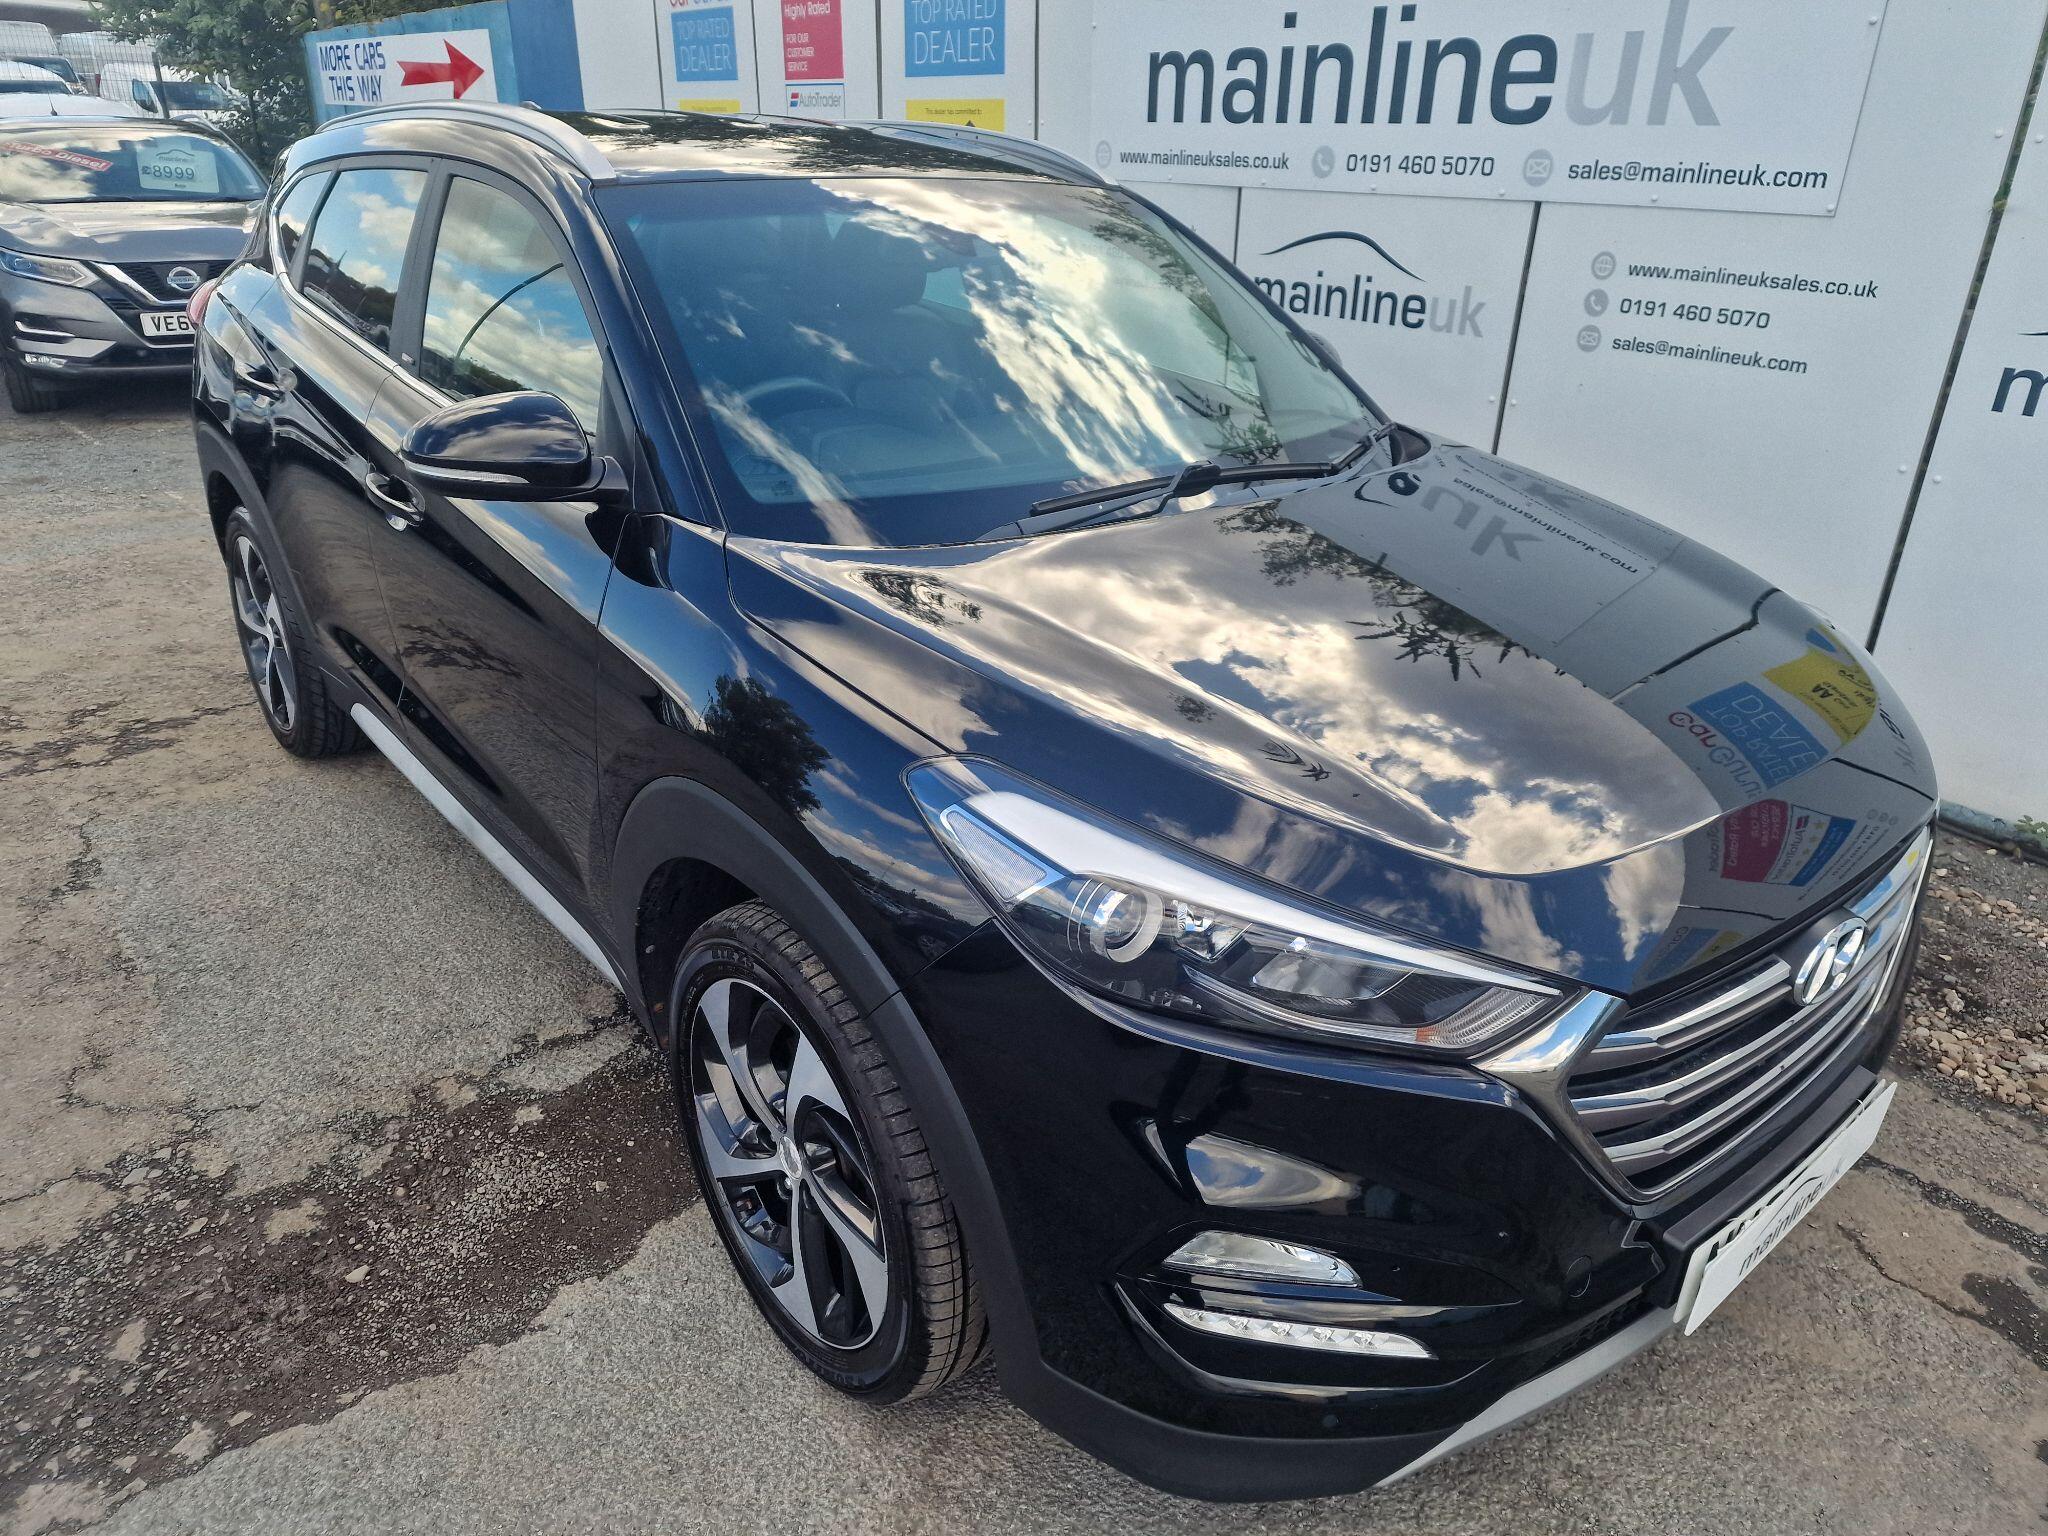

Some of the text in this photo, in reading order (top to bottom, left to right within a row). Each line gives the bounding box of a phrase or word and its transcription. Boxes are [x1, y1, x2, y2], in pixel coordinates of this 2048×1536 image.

[785, 1, 831, 20] Highly Rated
[911, 0, 997, 24] TOP RATED
[676, 17, 730, 41] TOP RATED
[319, 41, 386, 71] MORE CARS
[680, 43, 732, 72] DEALER
[914, 26, 996, 65] DEALER
[1147, 0, 1735, 126] mainlineuk
[328, 75, 383, 103] THIS WAY
[799, 92, 842, 108] AutoTrader
[54, 152, 107, 170] Diesel
[1120, 149, 1829, 190] www.mainlineuksales.co.uk 0191 460 5070 sales@mainlineuk.com
[1628, 263, 1879, 299] www.mainlineuksales.co.uk
[1253, 269, 1487, 338] mainlineuk
[1619, 298, 1771, 329] 0191 460 5070
[150, 315, 190, 332] VE6
[1611, 336, 1808, 374] sales@mainlineuk.com
